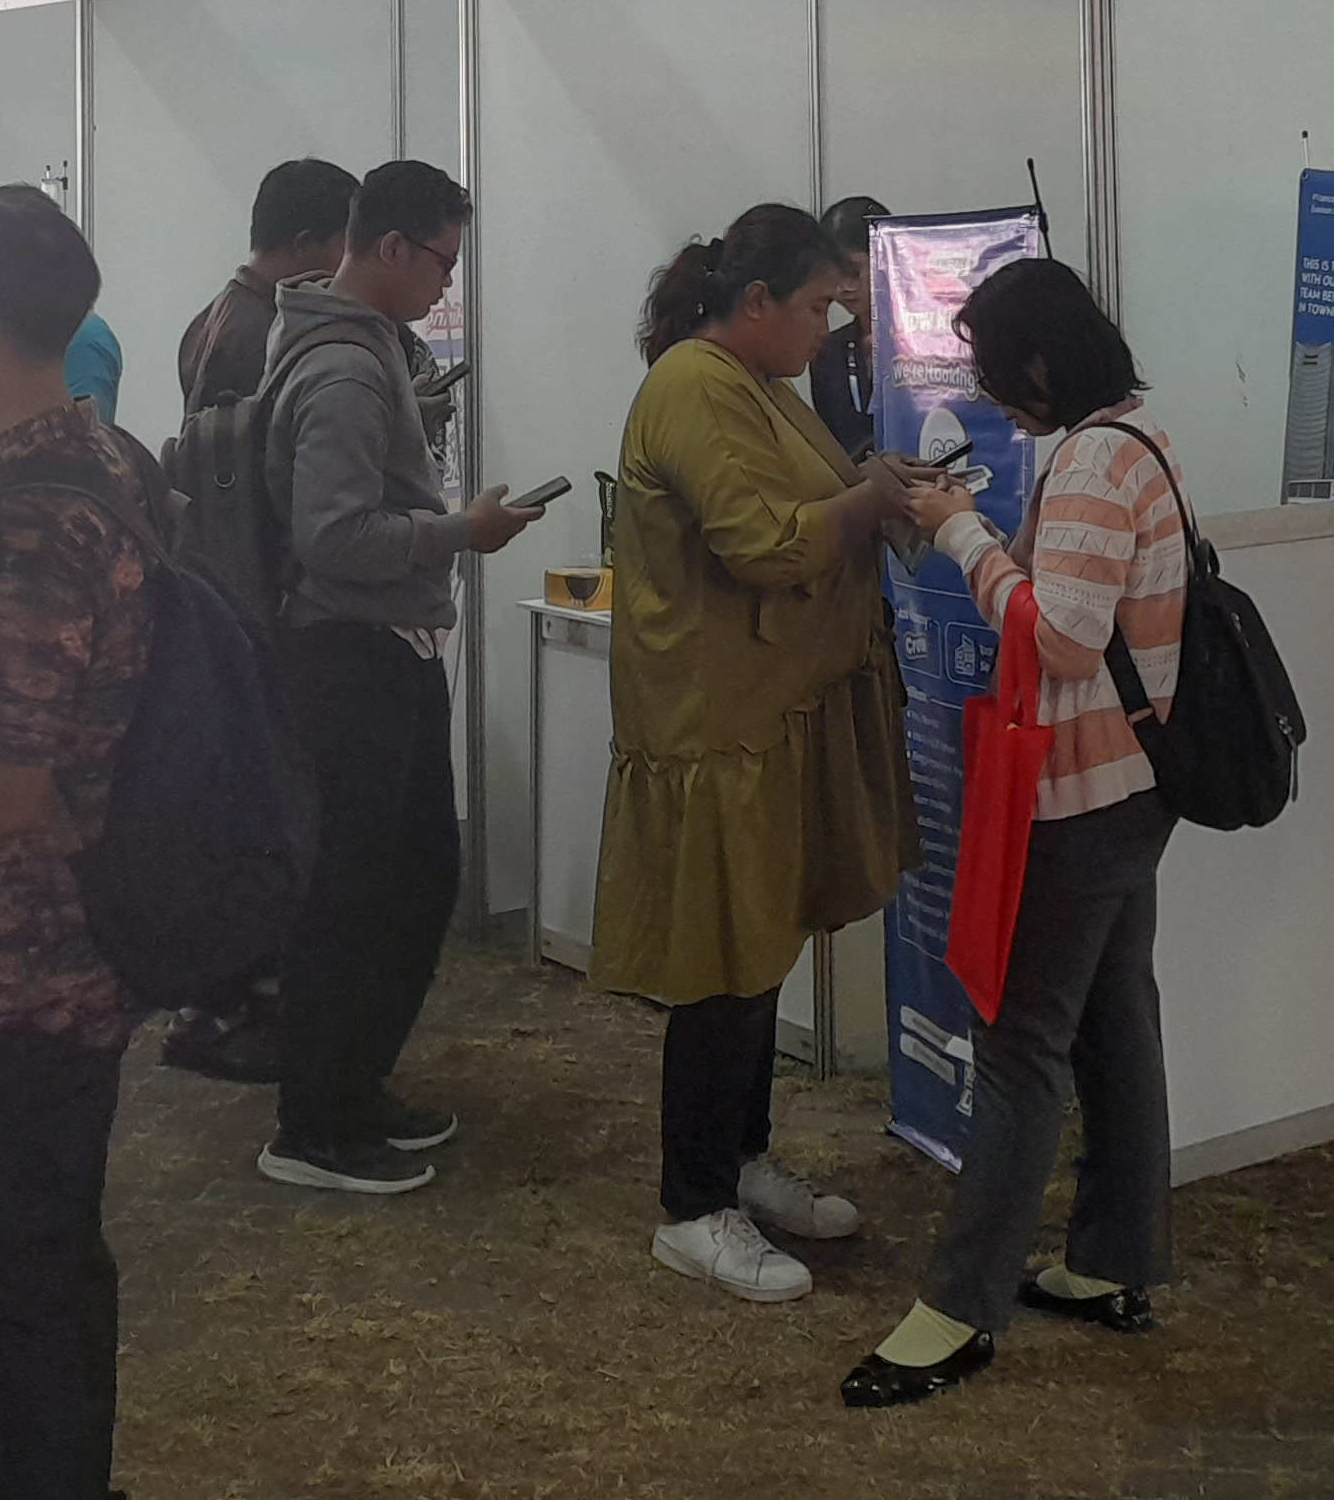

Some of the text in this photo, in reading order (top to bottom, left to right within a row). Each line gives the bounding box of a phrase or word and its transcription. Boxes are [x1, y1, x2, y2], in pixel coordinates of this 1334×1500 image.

[1303, 257, 1319, 270] THIS
[1321, 260, 1329, 271] IS
[1301, 273, 1322, 286] WITH
[1299, 286, 1321, 300] TEAM
[1298, 302, 1307, 313] IN
